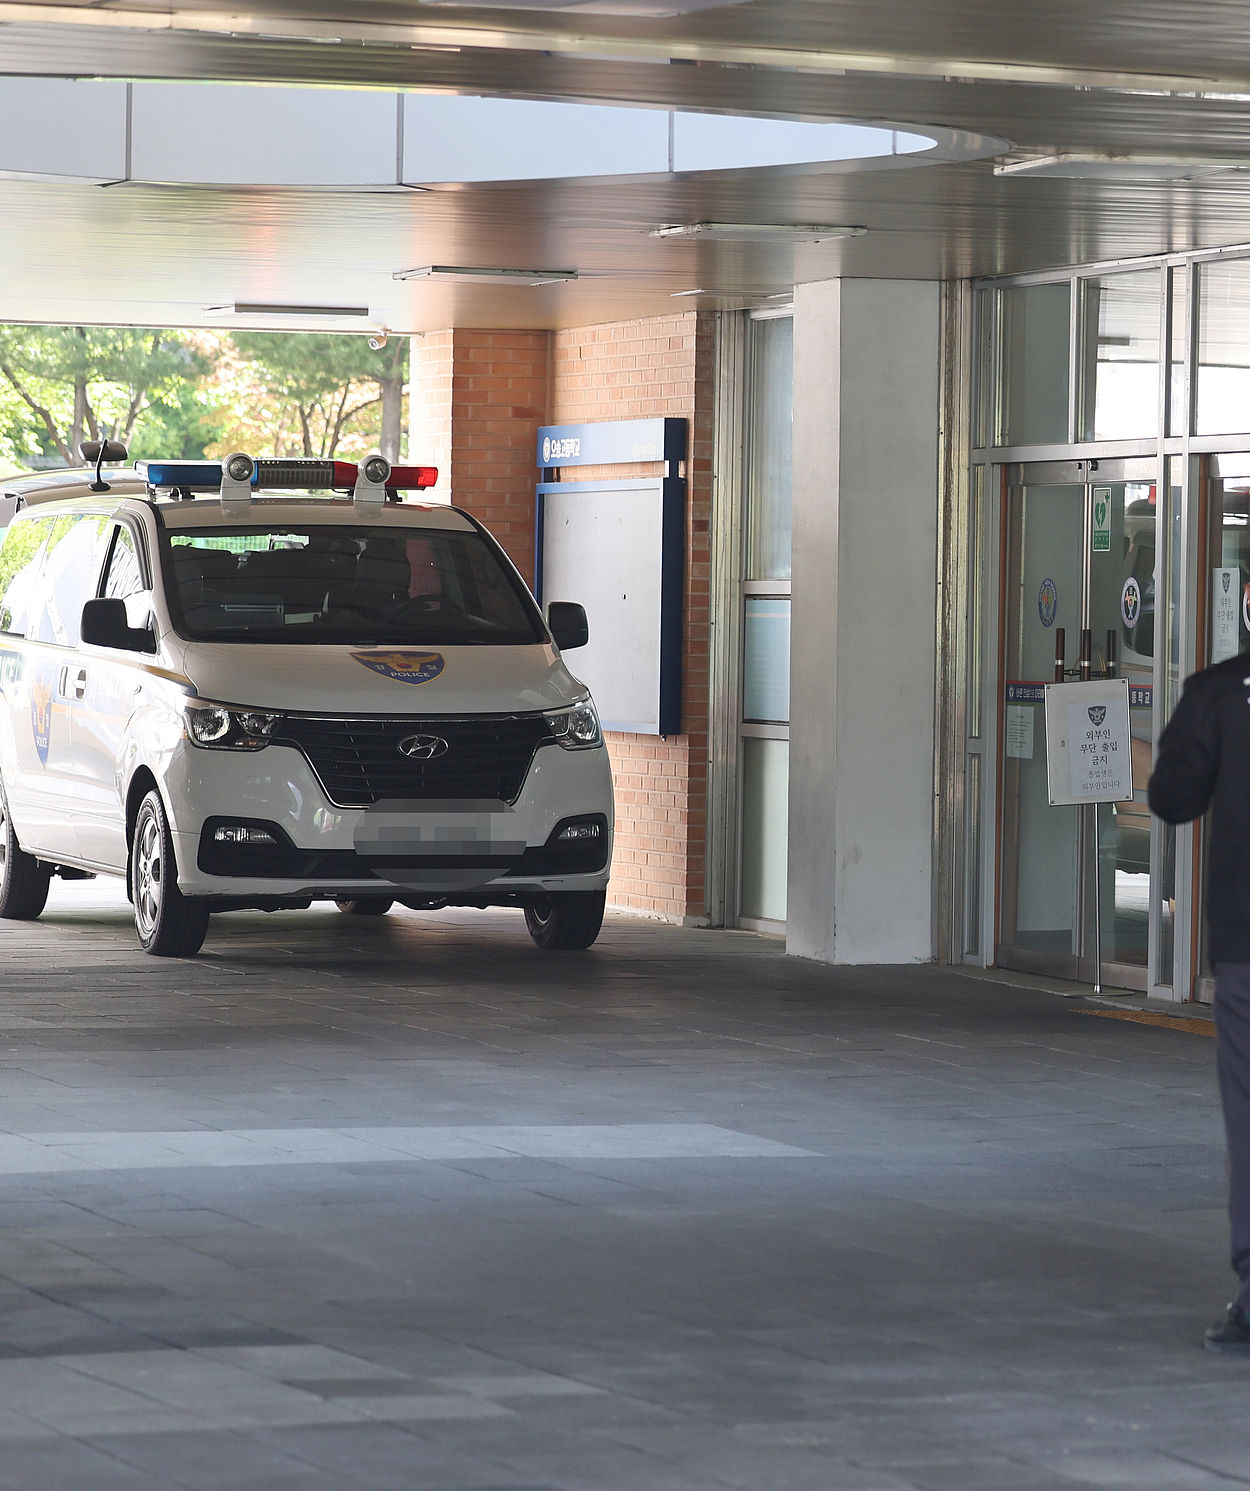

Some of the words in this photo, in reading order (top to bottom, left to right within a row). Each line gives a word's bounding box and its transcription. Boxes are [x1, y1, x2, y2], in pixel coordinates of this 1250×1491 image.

[1086, 729, 1111, 740] 외부인
[1080, 743, 1097, 754] 무단
[1101, 741, 1118, 752] 출입
[1092, 755, 1108, 766] 금지
[1088, 769, 1113, 779] 졸업생은
[1081, 780, 1120, 790] 외부인입니다
